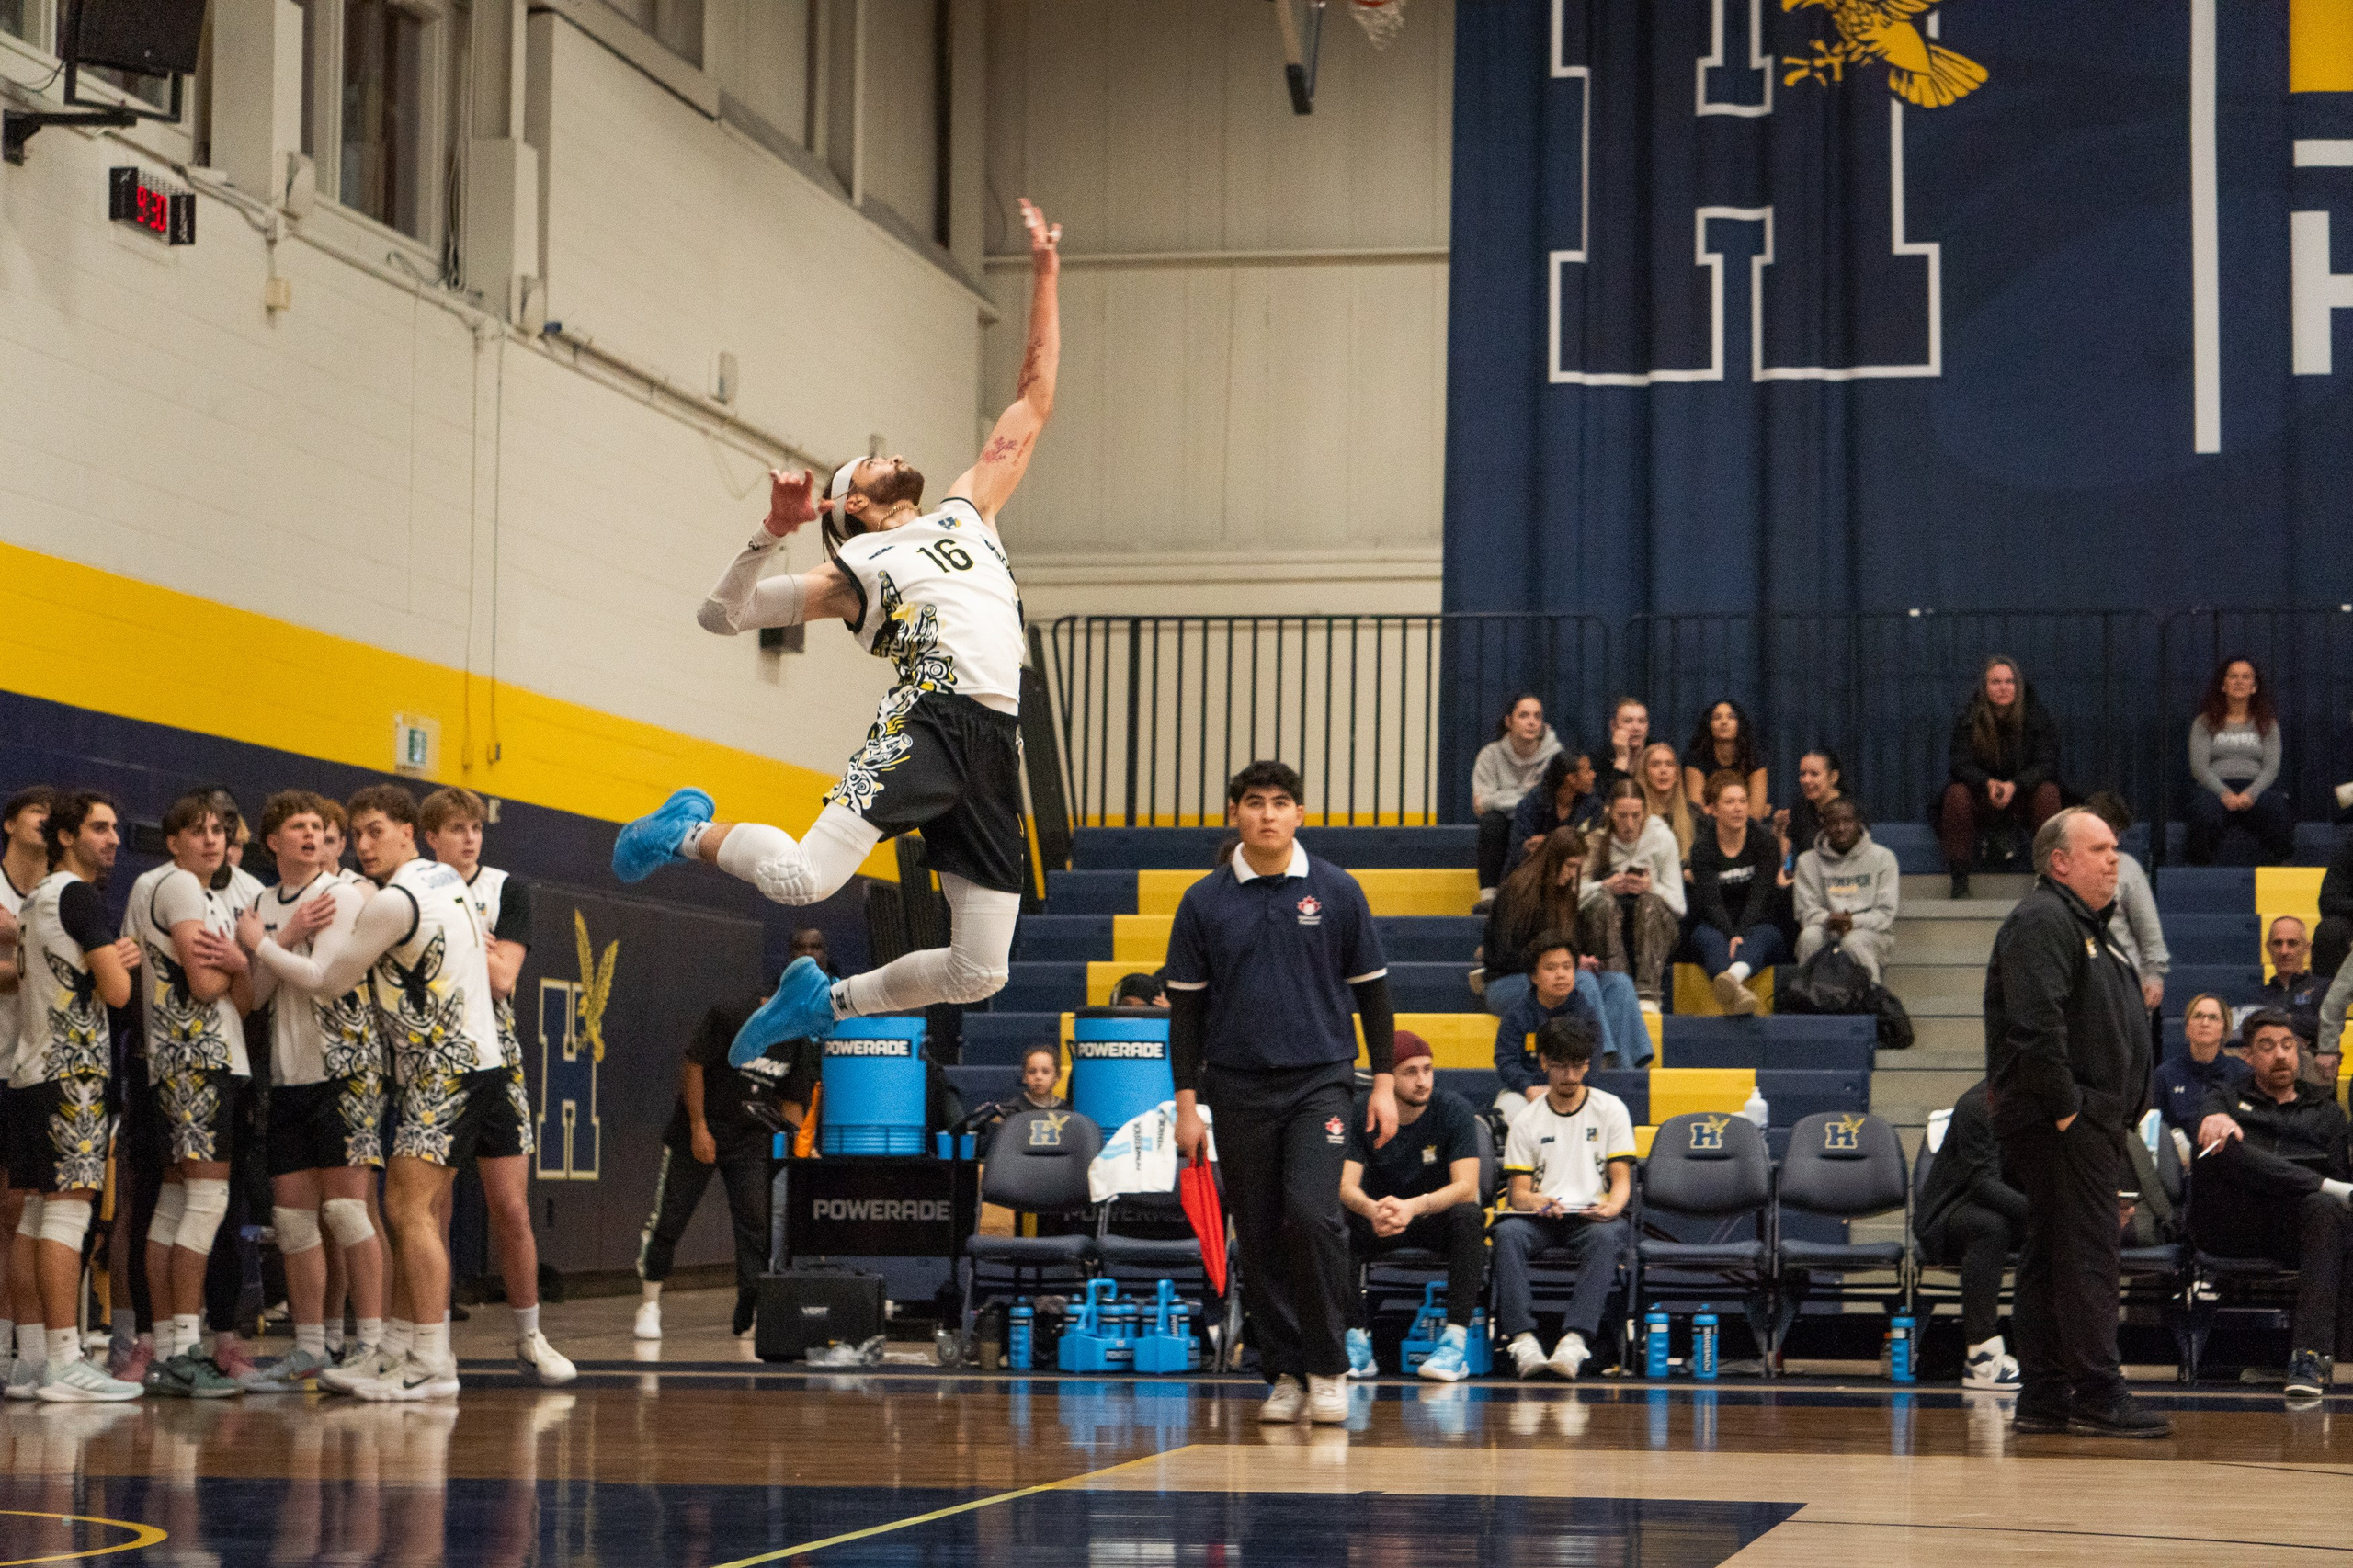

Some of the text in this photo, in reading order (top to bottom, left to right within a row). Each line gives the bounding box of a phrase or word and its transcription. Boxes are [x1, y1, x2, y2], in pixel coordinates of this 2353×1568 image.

[916, 539, 974, 573] 16
[825, 1040, 909, 1056] POWERADE
[1077, 1042, 1164, 1058] POWERADE
[536, 978, 600, 1180] H
[1689, 1122, 1722, 1149] H
[1824, 1122, 1858, 1149] H
[812, 1199, 951, 1221] POWERADE
